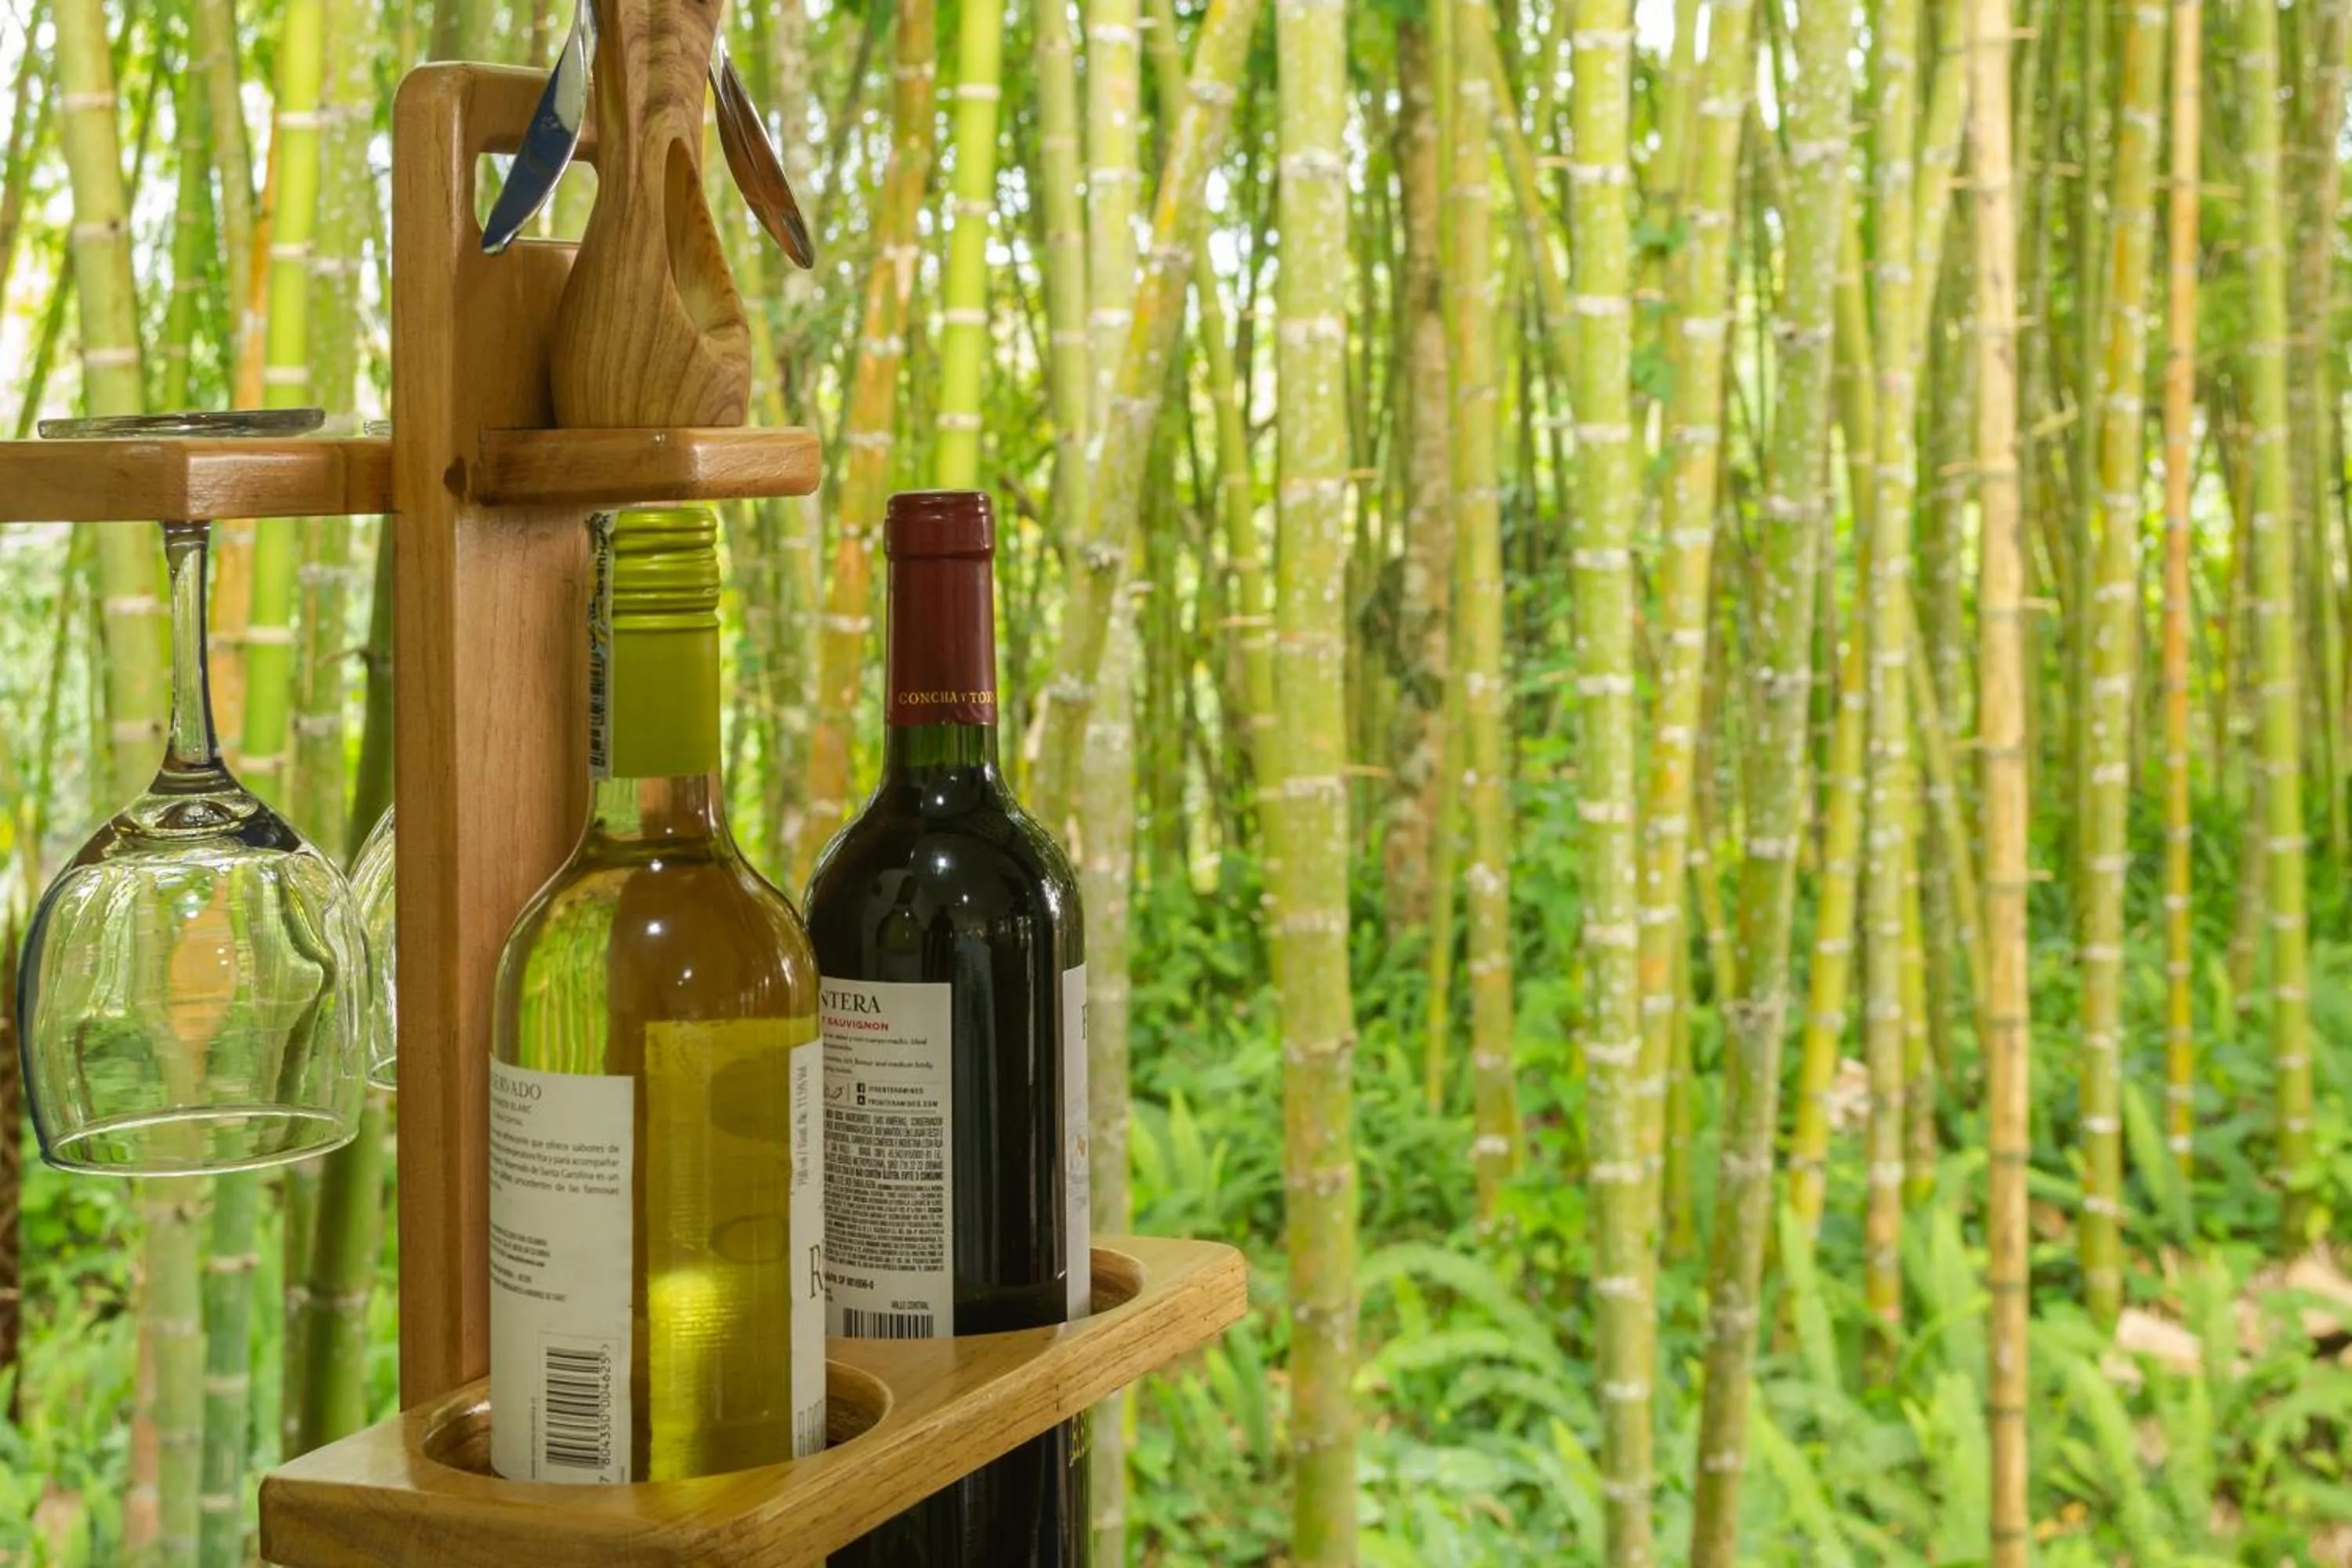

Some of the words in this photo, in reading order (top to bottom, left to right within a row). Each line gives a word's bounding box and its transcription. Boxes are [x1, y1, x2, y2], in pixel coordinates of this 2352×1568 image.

[898, 691, 957, 705] CONCHA
[827, 1016, 889, 1032] SAUVIGNON
[572, 1143, 604, 1153] sabores
[607, 1144, 619, 1153] de
[561, 1169, 594, 1180] Carolina
